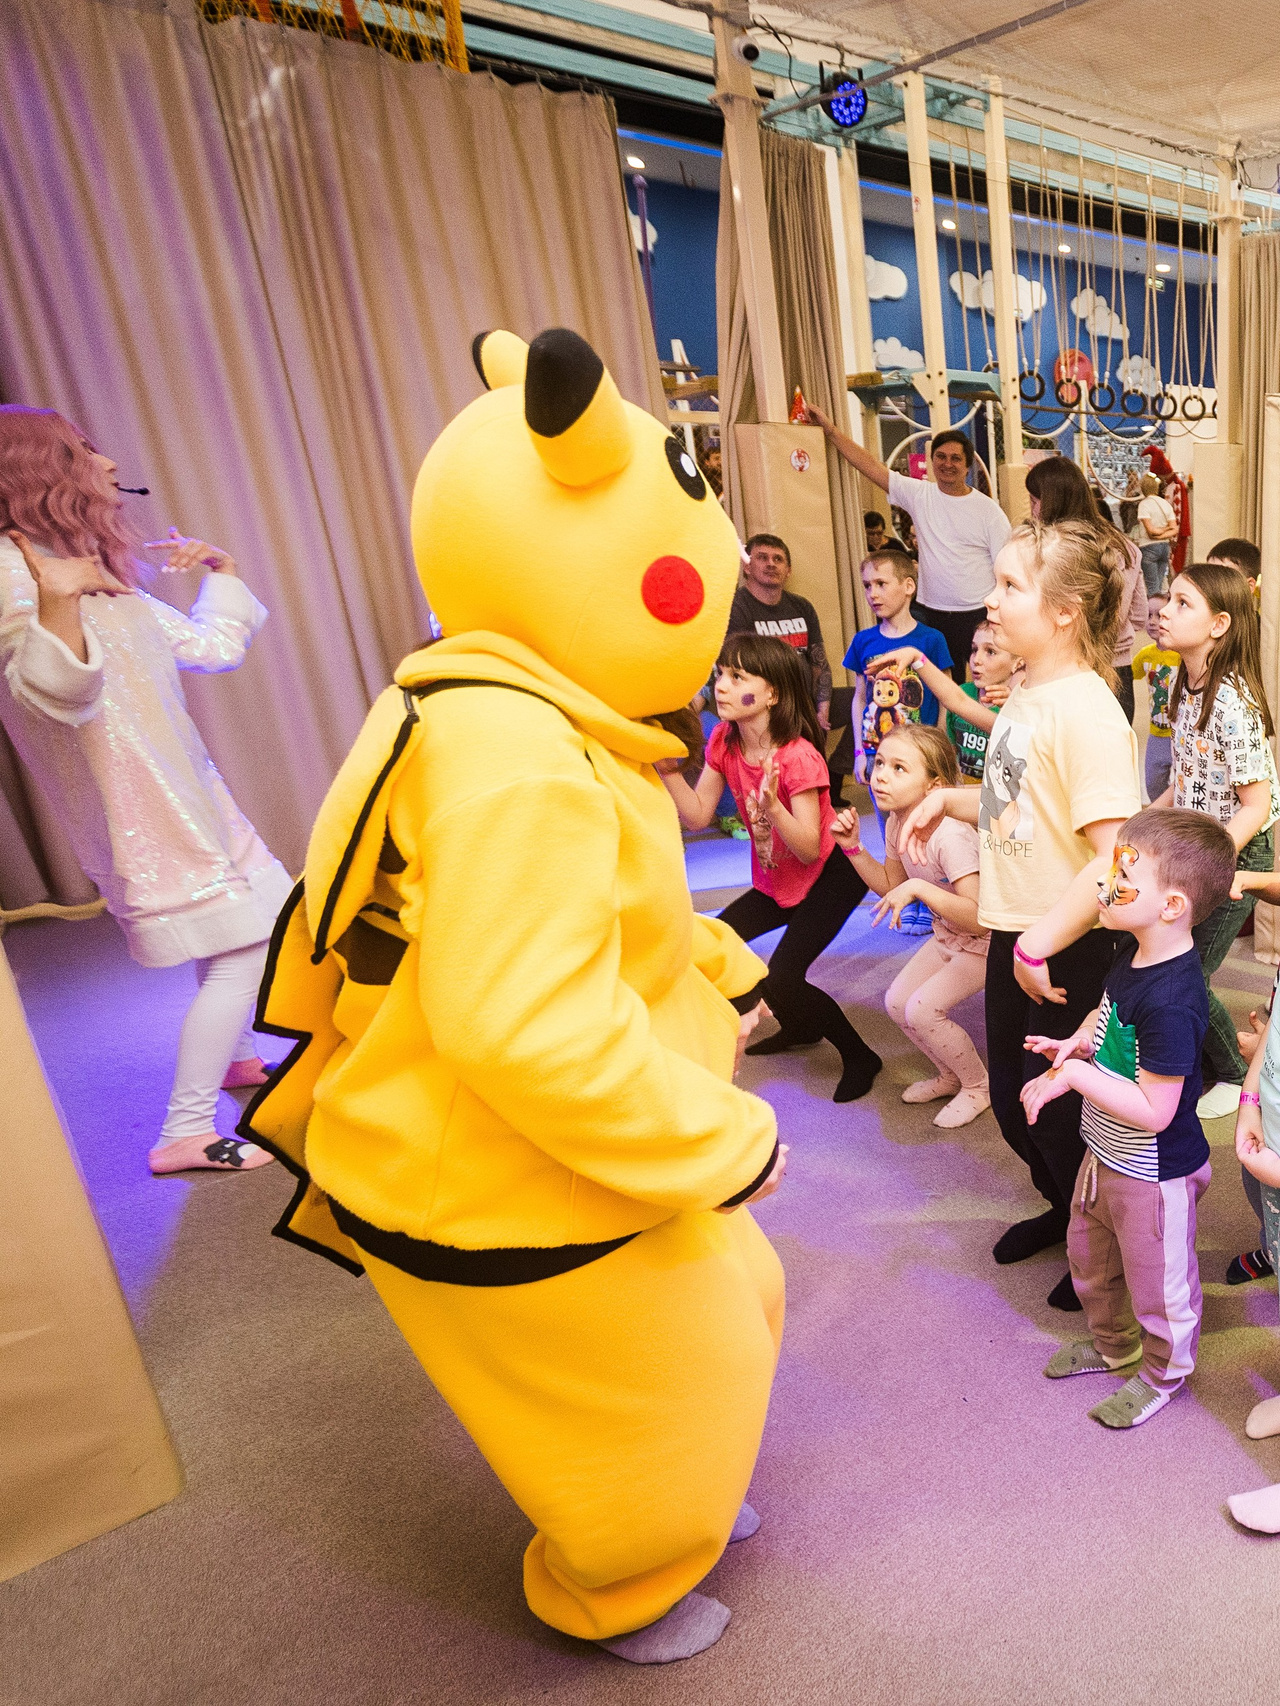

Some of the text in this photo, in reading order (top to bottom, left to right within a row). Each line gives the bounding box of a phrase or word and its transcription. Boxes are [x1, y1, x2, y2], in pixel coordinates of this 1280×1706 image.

[754, 617, 808, 637] HARD
[962, 731, 990, 752] 199
[983, 834, 1033, 858] & HOPE
